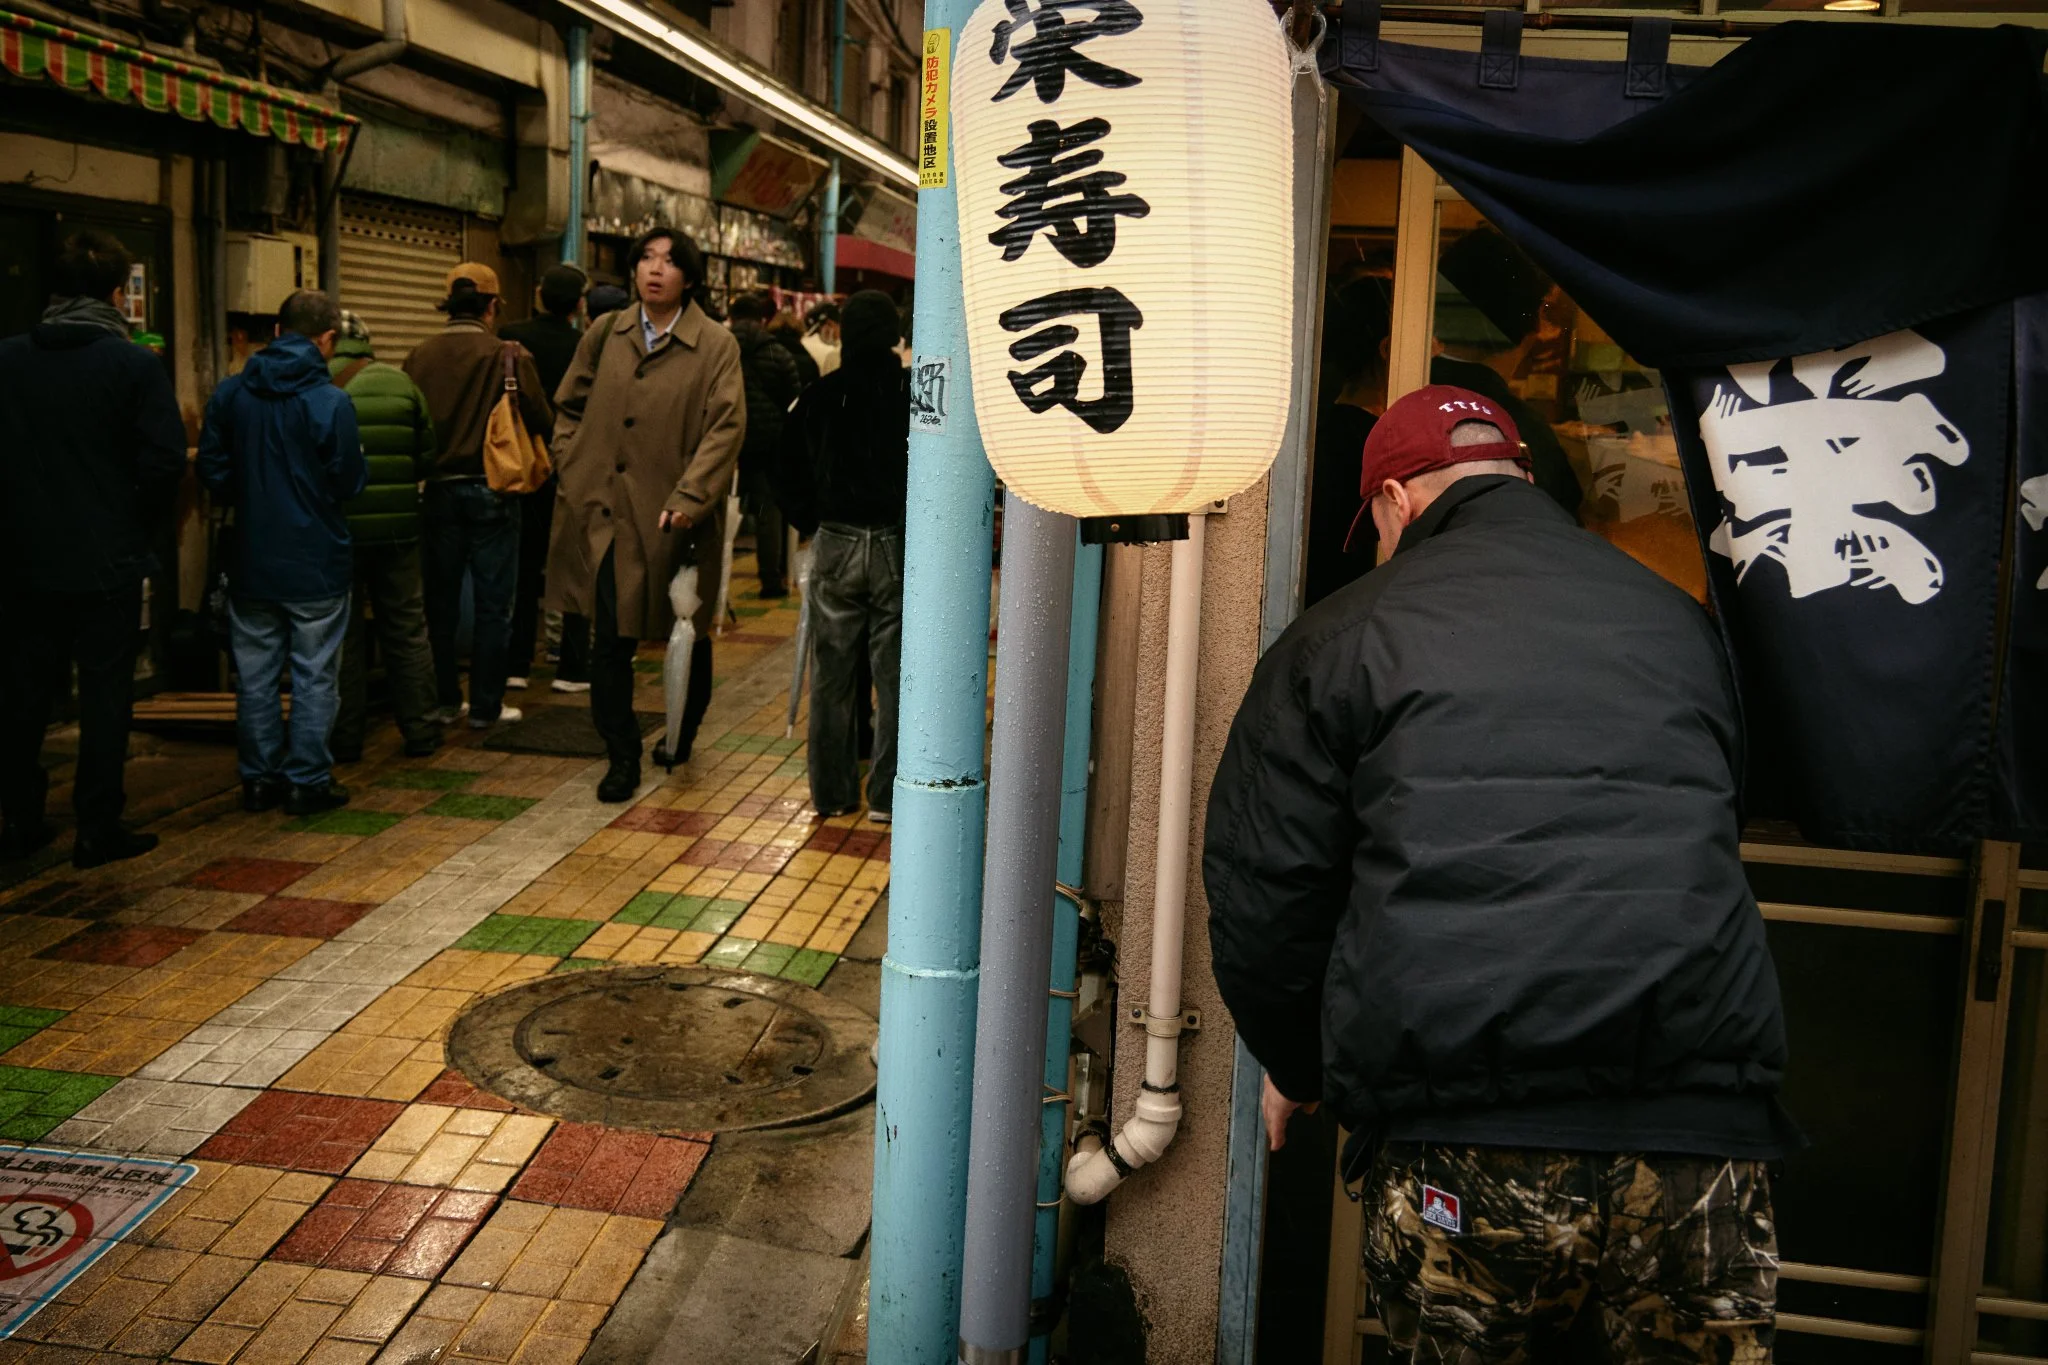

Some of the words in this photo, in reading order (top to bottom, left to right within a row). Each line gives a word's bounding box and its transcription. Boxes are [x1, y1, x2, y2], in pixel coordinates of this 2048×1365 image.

[923, 56, 939, 169] 防犯カメラ設置地区
[989, 0, 1150, 434] 栄寿司
[0, 1175, 16, 1183] lic
